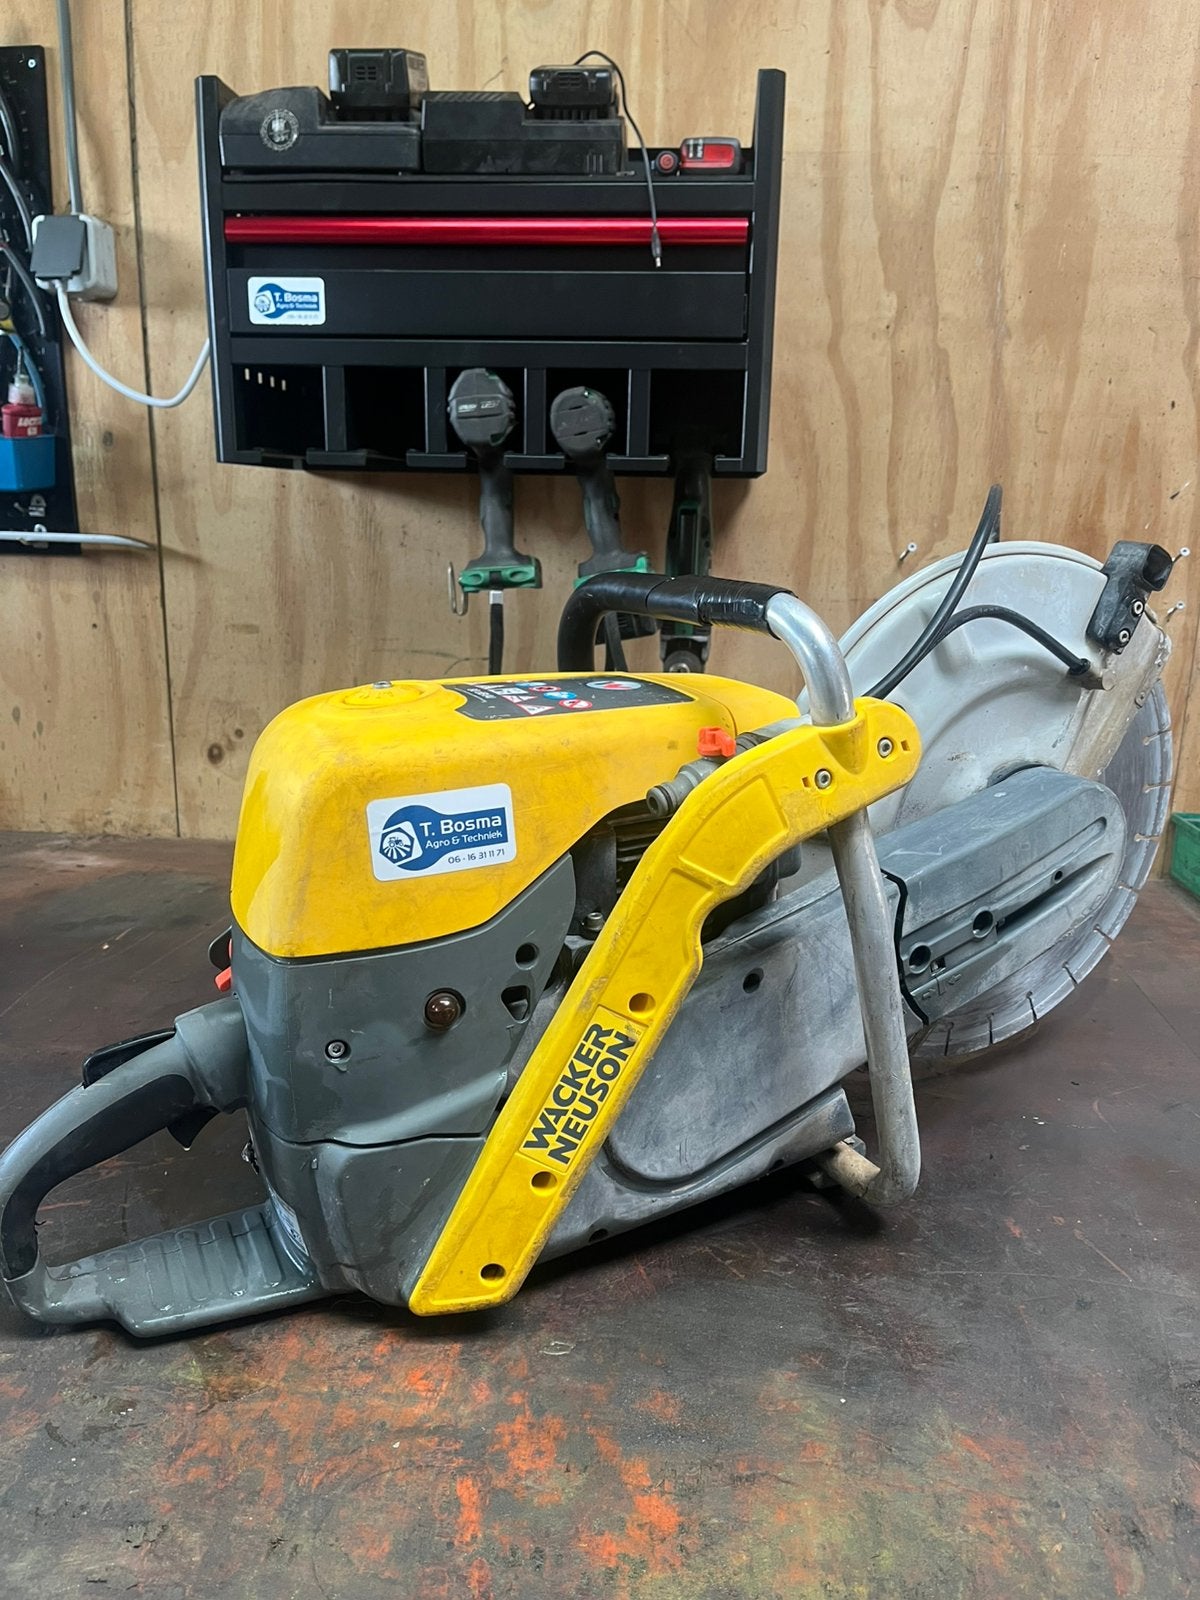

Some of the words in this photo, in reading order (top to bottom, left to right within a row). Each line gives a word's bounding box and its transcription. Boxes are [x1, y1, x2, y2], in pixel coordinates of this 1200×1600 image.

[274, 292, 283, 302] T.
[284, 292, 318, 302] Bosma
[420, 821, 435, 837] T.
[440, 815, 502, 835] Bosma
[425, 839, 450, 850] Agro
[451, 837, 461, 845] &
[462, 830, 503, 844] Techniek
[448, 855, 461, 864] 06
[467, 853, 477, 862] 16
[478, 851, 488, 860] 31
[488, 850, 495, 858] 11
[496, 848, 505, 857] 71
[522, 1023, 614, 1149] WACKER
[547, 1032, 637, 1165] NEUSON
